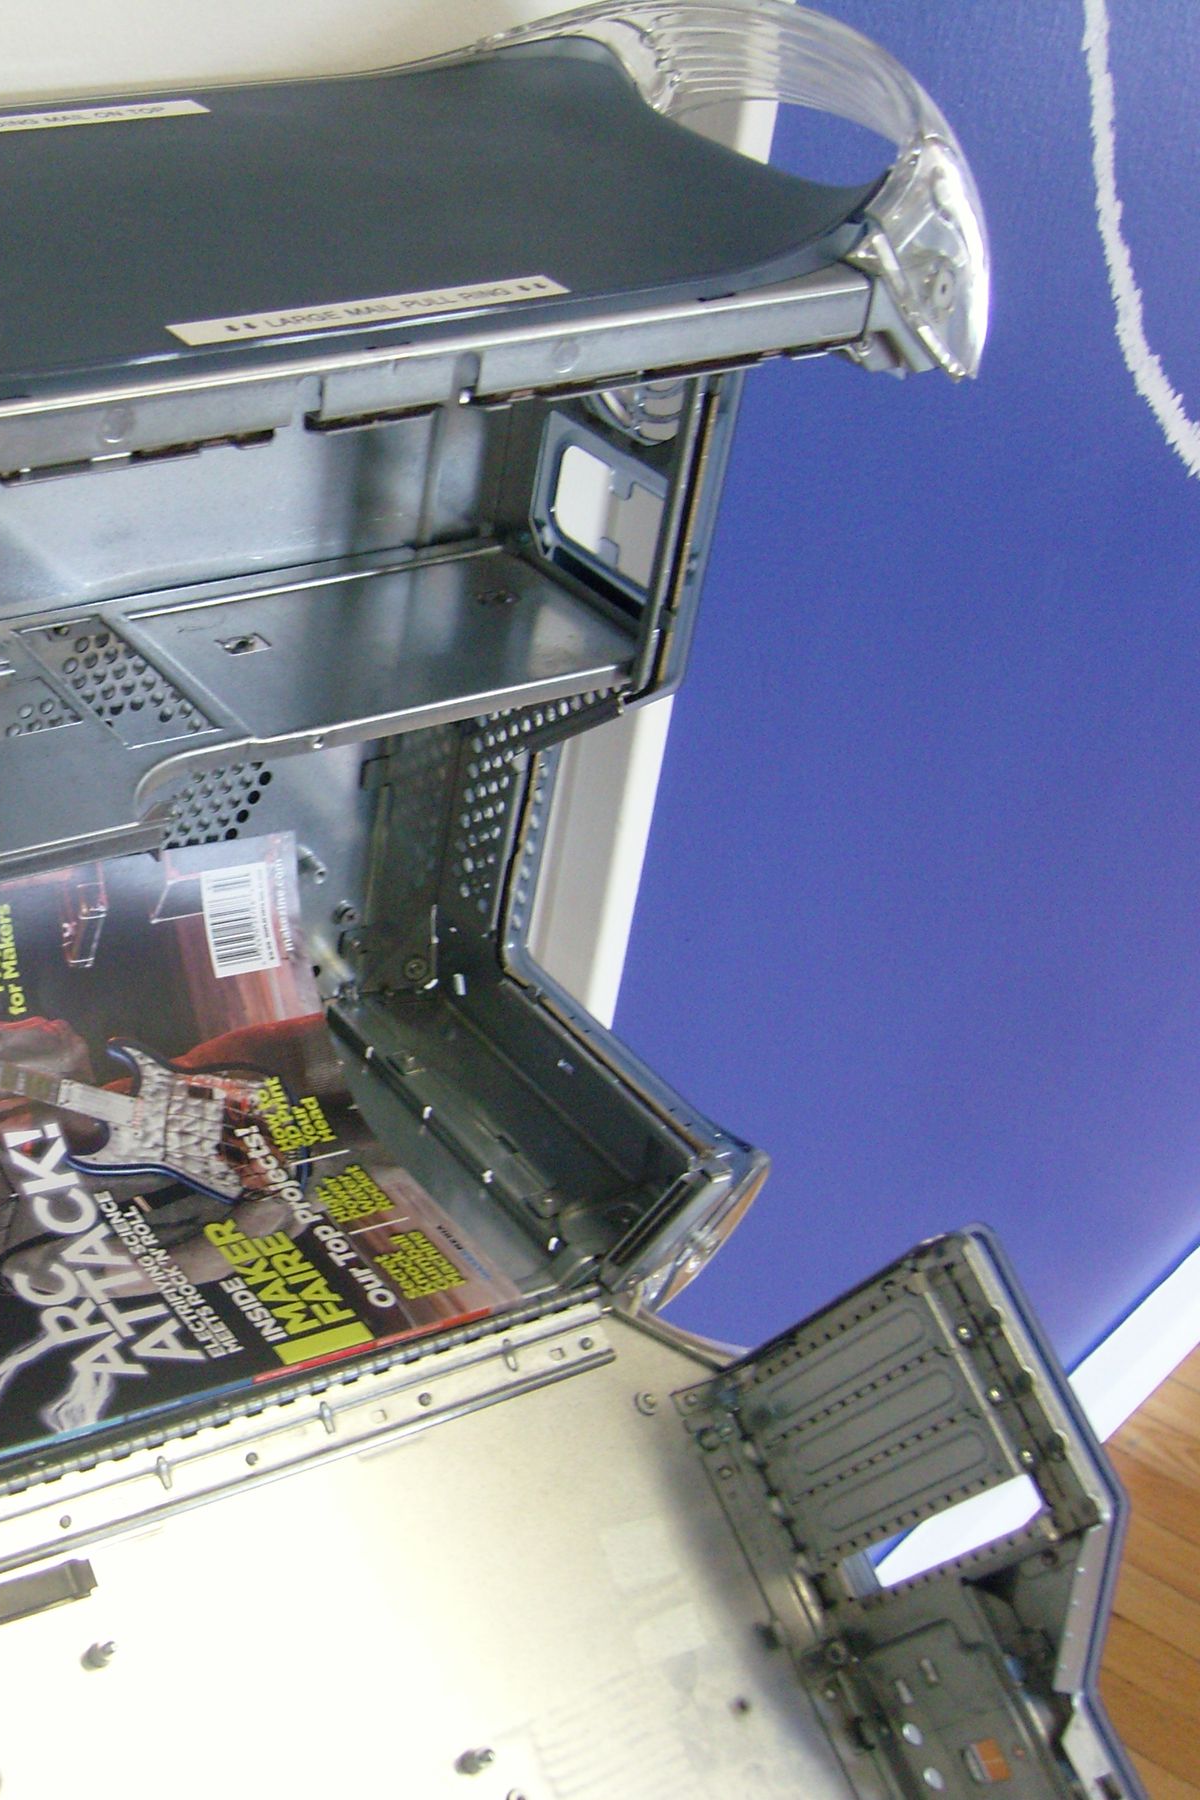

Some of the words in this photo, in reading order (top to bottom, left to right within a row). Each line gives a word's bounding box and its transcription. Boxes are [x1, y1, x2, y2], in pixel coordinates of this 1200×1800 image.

[43, 113, 90, 124] MAIL
[94, 108, 123, 119] ON
[125, 105, 166, 117] TOP
[265, 308, 339, 329] LARGE
[345, 303, 401, 321] MAIL
[401, 295, 450, 312] PULL
[458, 287, 511, 304] RING
[274, 858, 295, 952] makezine.com
[7, 983, 28, 1016] for
[256, 1088, 272, 1111] to
[263, 1075, 295, 1123] Print
[300, 1096, 338, 1143] Head
[262, 1112, 297, 1152] How
[291, 1105, 322, 1147] Your
[233, 1124, 325, 1226] Projects!
[321, 1176, 364, 1219] Power
[335, 1174, 378, 1216] Water
[344, 1164, 396, 1211] Rocket
[2, 1121, 208, 1361] ATTACK!
[93, 1190, 148, 1255] SCIENCE
[122, 1205, 160, 1246] ROLL
[203, 1218, 322, 1336] MAKER
[250, 1230, 357, 1326] FAIRE
[373, 1253, 417, 1300] Secret
[388, 1233, 450, 1291] Gumball
[389, 1250, 438, 1296] Knock
[407, 1231, 467, 1289] Machine
[163, 1264, 207, 1306] ROCK
[12, 1262, 149, 1375] ARC
[194, 1305, 245, 1355] MEETS
[219, 1276, 290, 1343] INSIDE
